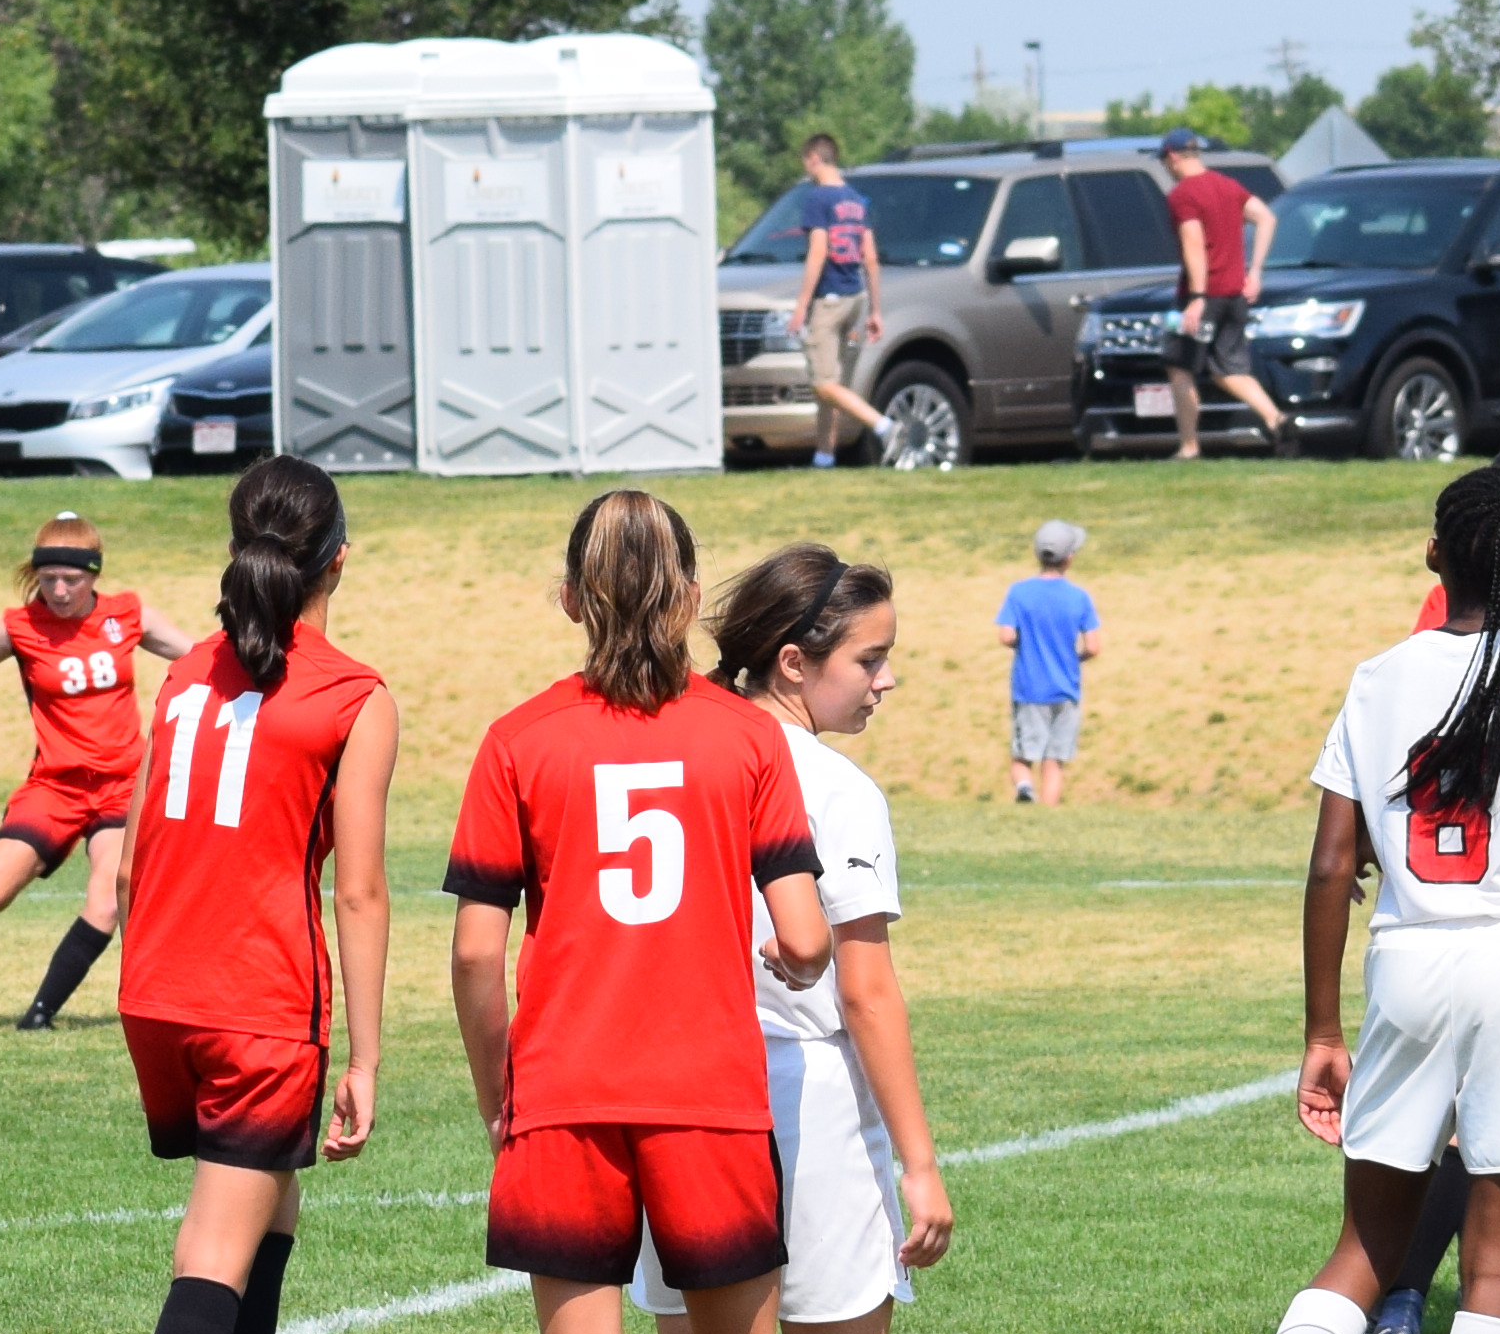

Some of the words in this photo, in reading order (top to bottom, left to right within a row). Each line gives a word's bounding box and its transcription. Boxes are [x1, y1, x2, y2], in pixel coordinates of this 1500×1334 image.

[58, 651, 118, 695] 38
[165, 683, 264, 828] 11
[1406, 736, 1492, 884] 8
[593, 760, 685, 925] 5
